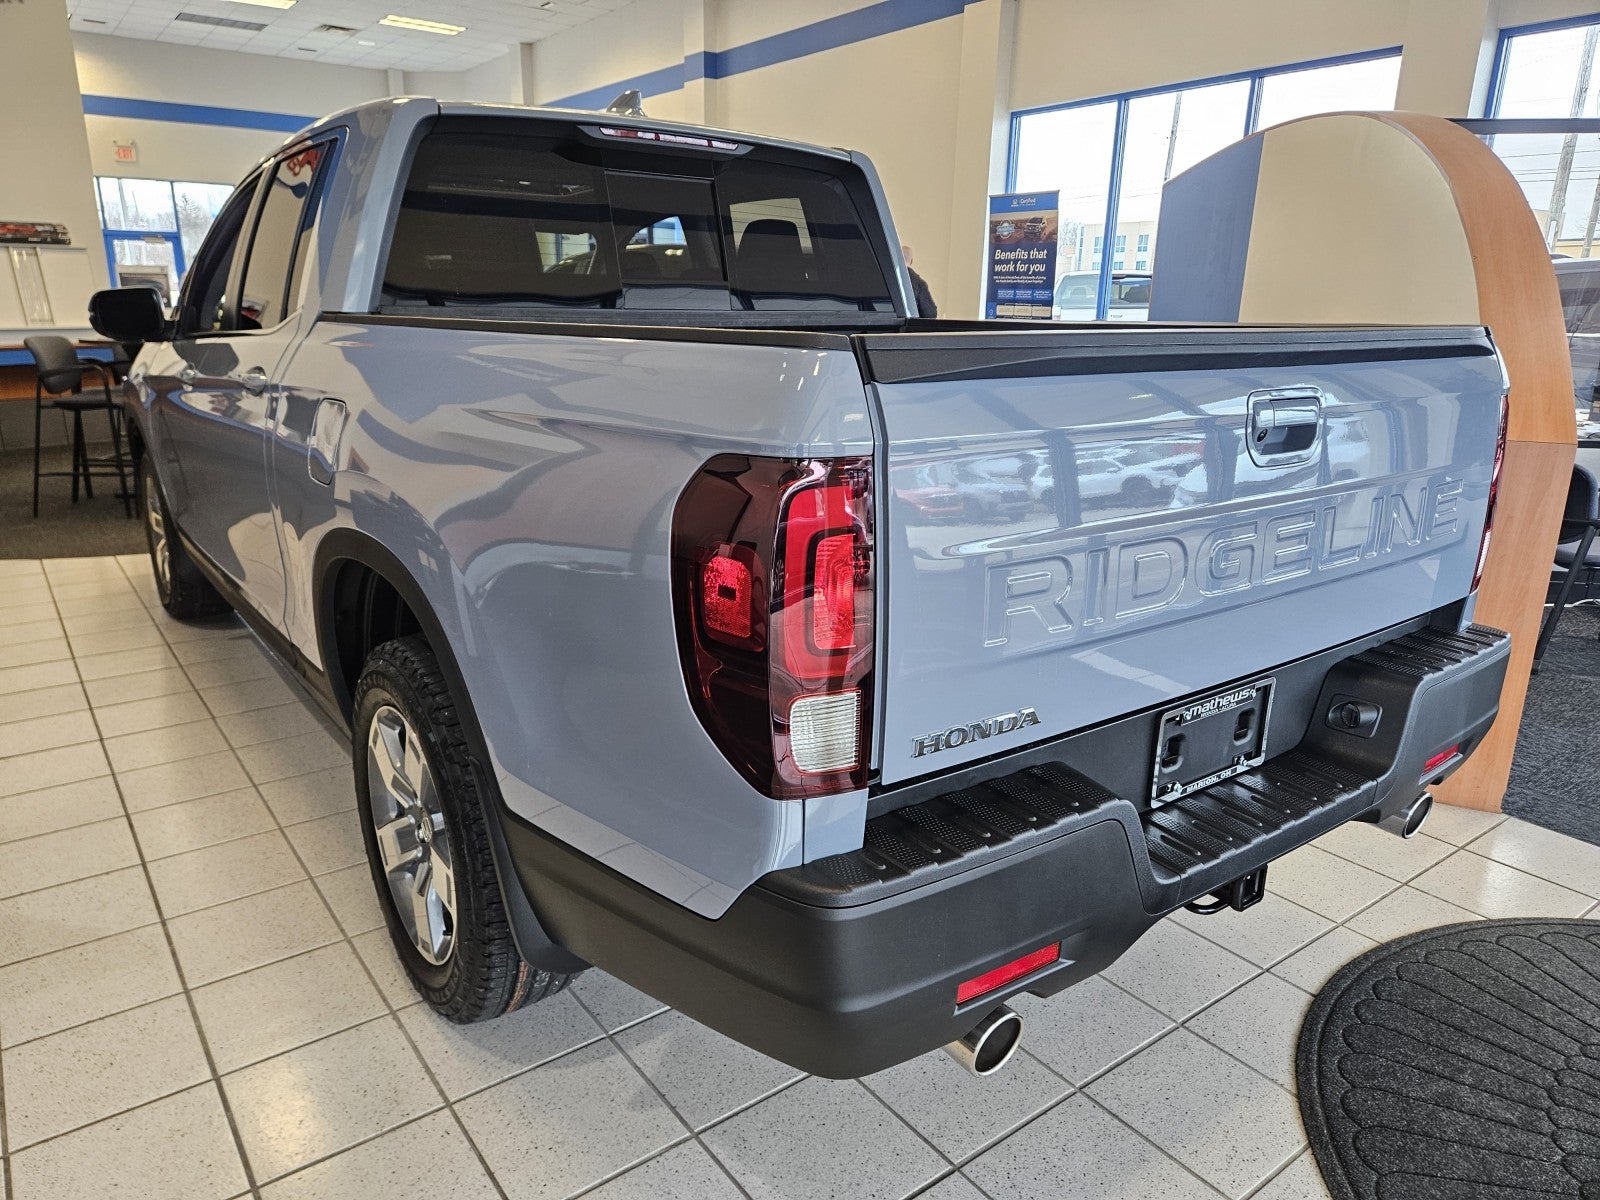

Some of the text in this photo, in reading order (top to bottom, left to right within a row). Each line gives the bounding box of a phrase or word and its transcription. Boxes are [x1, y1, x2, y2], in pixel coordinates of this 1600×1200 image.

[994, 247, 1047, 260] Benefits that
[994, 260, 1046, 275] work for you
[983, 476, 1465, 648] RIDGELINE
[1189, 688, 1251, 716] mathews
[911, 706, 1041, 758] HONDA
